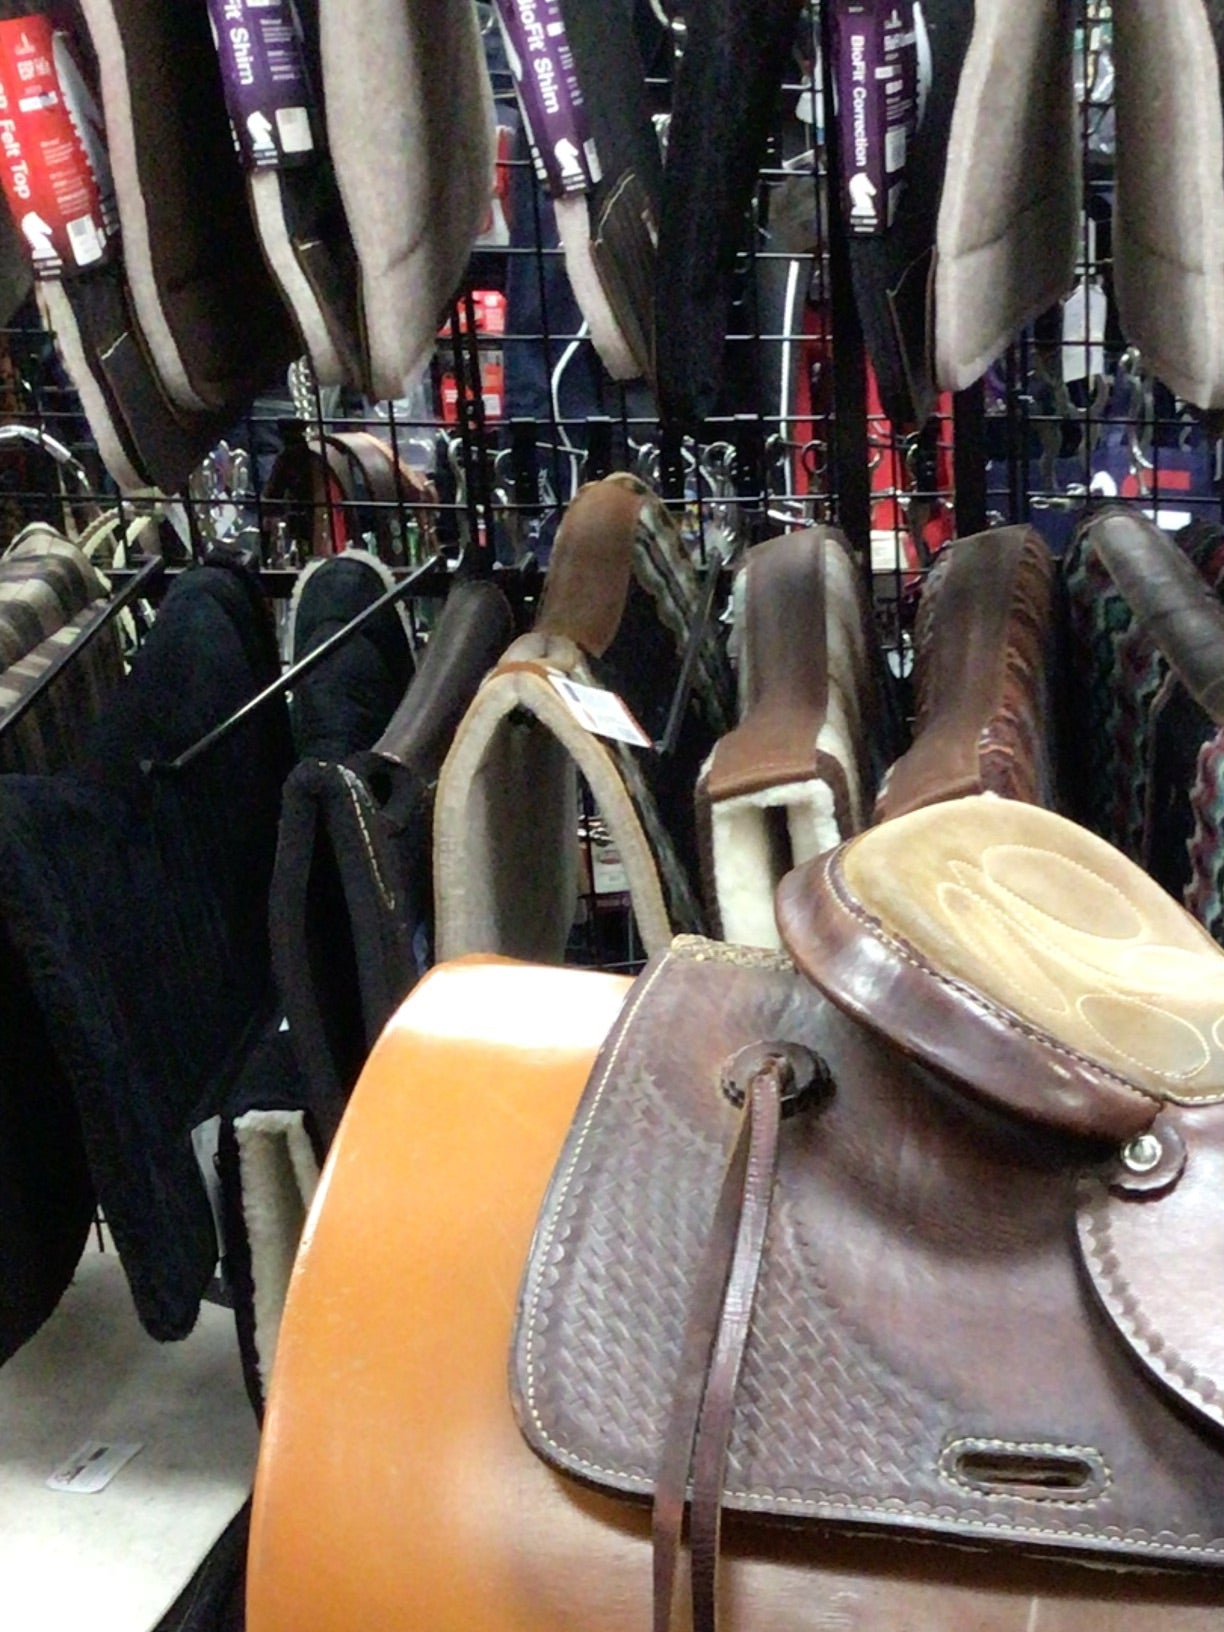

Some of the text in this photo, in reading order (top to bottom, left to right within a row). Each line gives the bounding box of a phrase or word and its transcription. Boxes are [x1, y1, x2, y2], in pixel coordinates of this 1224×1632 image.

[229, 27, 255, 86] Shim
[532, 57, 560, 114] Shim
[0, 119, 31, 200] Felt Top
[852, 86, 869, 167] Correction
